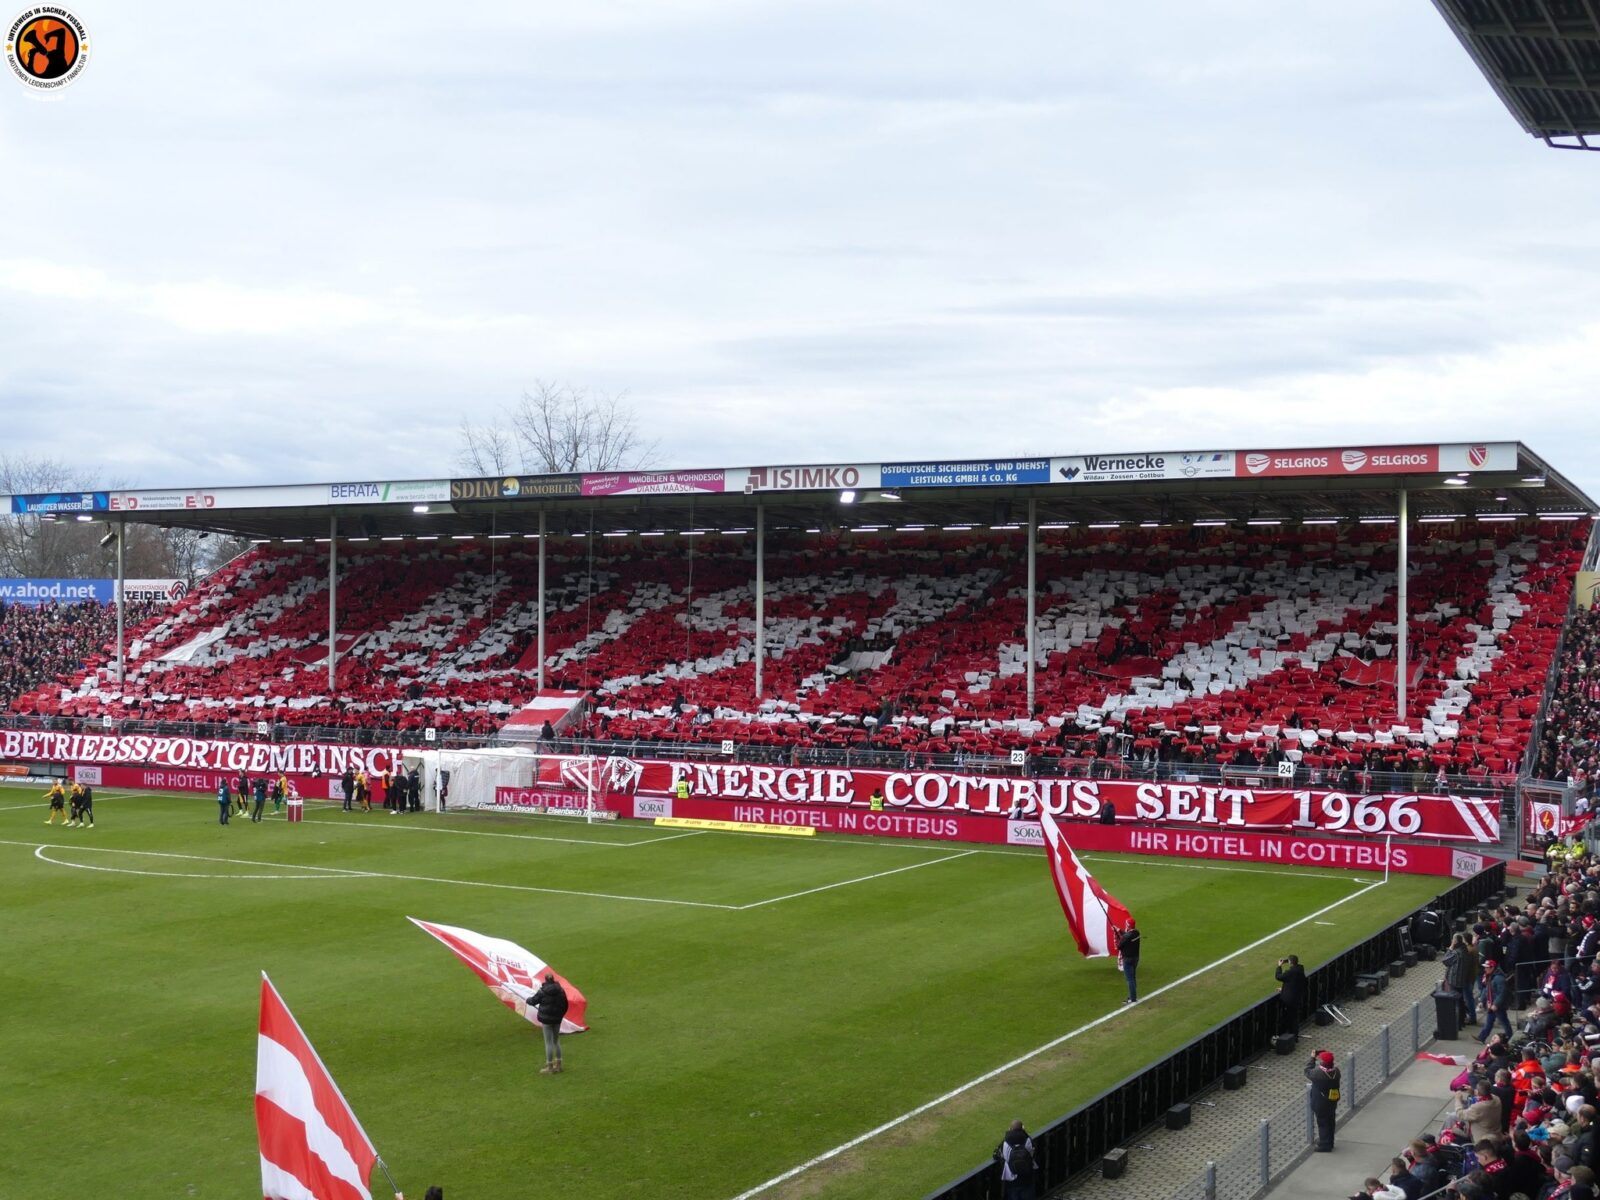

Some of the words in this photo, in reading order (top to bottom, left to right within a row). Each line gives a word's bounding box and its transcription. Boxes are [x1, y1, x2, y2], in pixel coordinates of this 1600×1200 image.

[1084, 454, 1165, 471] Wernecke
[1274, 457, 1328, 468] SELGROS
[1372, 454, 1428, 466] SELGROS
[881, 465, 936, 474] OSTDEUTSCHE
[938, 463, 993, 473] SICHERHEITS-
[995, 462, 1014, 471] UND
[1016, 461, 1049, 470] DIENST-
[628, 475, 668, 484] IMMOBILIEN
[670, 475, 675, 483] &
[677, 473, 724, 482] WOHNDESIGN
[772, 467, 860, 489] ISIMKO
[910, 475, 953, 484] LEISTUNGS
[955, 474, 979, 483] GMBH
[981, 474, 987, 482] &
[990, 473, 1004, 482] CO.
[1006, 473, 1018, 482] KG
[331, 483, 380, 498] BERATA
[451, 480, 499, 499] SDIM
[521, 483, 582, 495] IMMOBILIEN
[636, 485, 660, 493] DIANA
[27, 503, 58, 512] LAUSITZER
[58, 501, 82, 511] WASSER
[427, 730, 435, 739] 21
[723, 742, 732, 752] 22
[1012, 752, 1023, 764] 23
[1280, 764, 1292, 775] 24
[144, 771, 165, 785] IHR
[168, 774, 211, 789] HOTEL
[499, 790, 514, 805] IN
[669, 761, 854, 803] ENERGIE
[884, 773, 1101, 817] COTTBUS
[1135, 782, 1255, 825] SEIT
[1292, 790, 1422, 834] 1966
[638, 803, 664, 813] SORAT
[734, 806, 765, 823] IHR
[770, 807, 832, 828] HOTEL
[838, 812, 857, 830] IN
[863, 814, 959, 837] COTTBUS
[1013, 827, 1043, 839] SORA
[1130, 831, 1168, 850] IHR
[1175, 834, 1253, 856] HOTEL
[1260, 839, 1282, 858] IN
[1290, 841, 1408, 867] COTTBUS
[1456, 859, 1477, 873] SORAT
